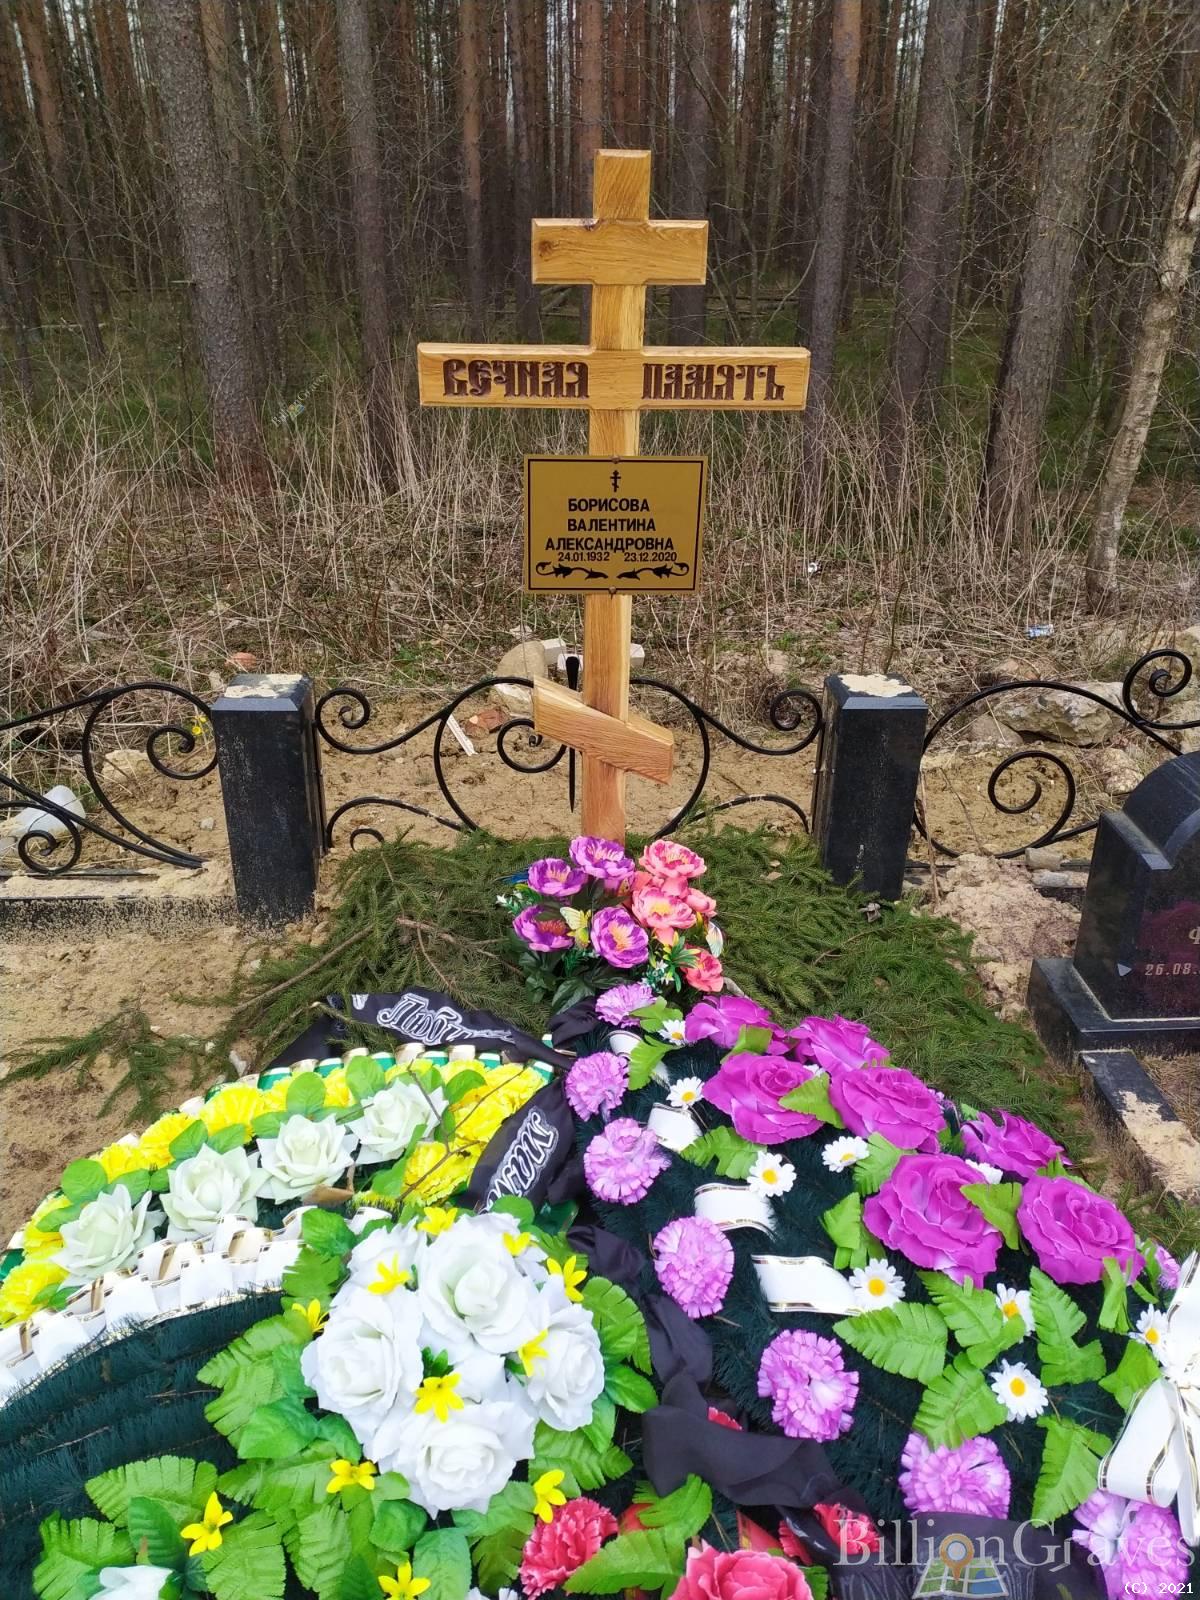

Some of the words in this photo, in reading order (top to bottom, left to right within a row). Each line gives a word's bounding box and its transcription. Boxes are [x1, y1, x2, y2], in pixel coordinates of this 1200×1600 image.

[568, 498, 650, 512] БОРИСОВА
[567, 518, 656, 532] ВАЛЕНТИНА
[545, 537, 675, 553] АЛЕКСАНДРОВНА
[557, 551, 610, 562] 24.01.1932
[623, 551, 677, 562] 23.12.2020
[1144, 963, 1200, 976] 26.08.
